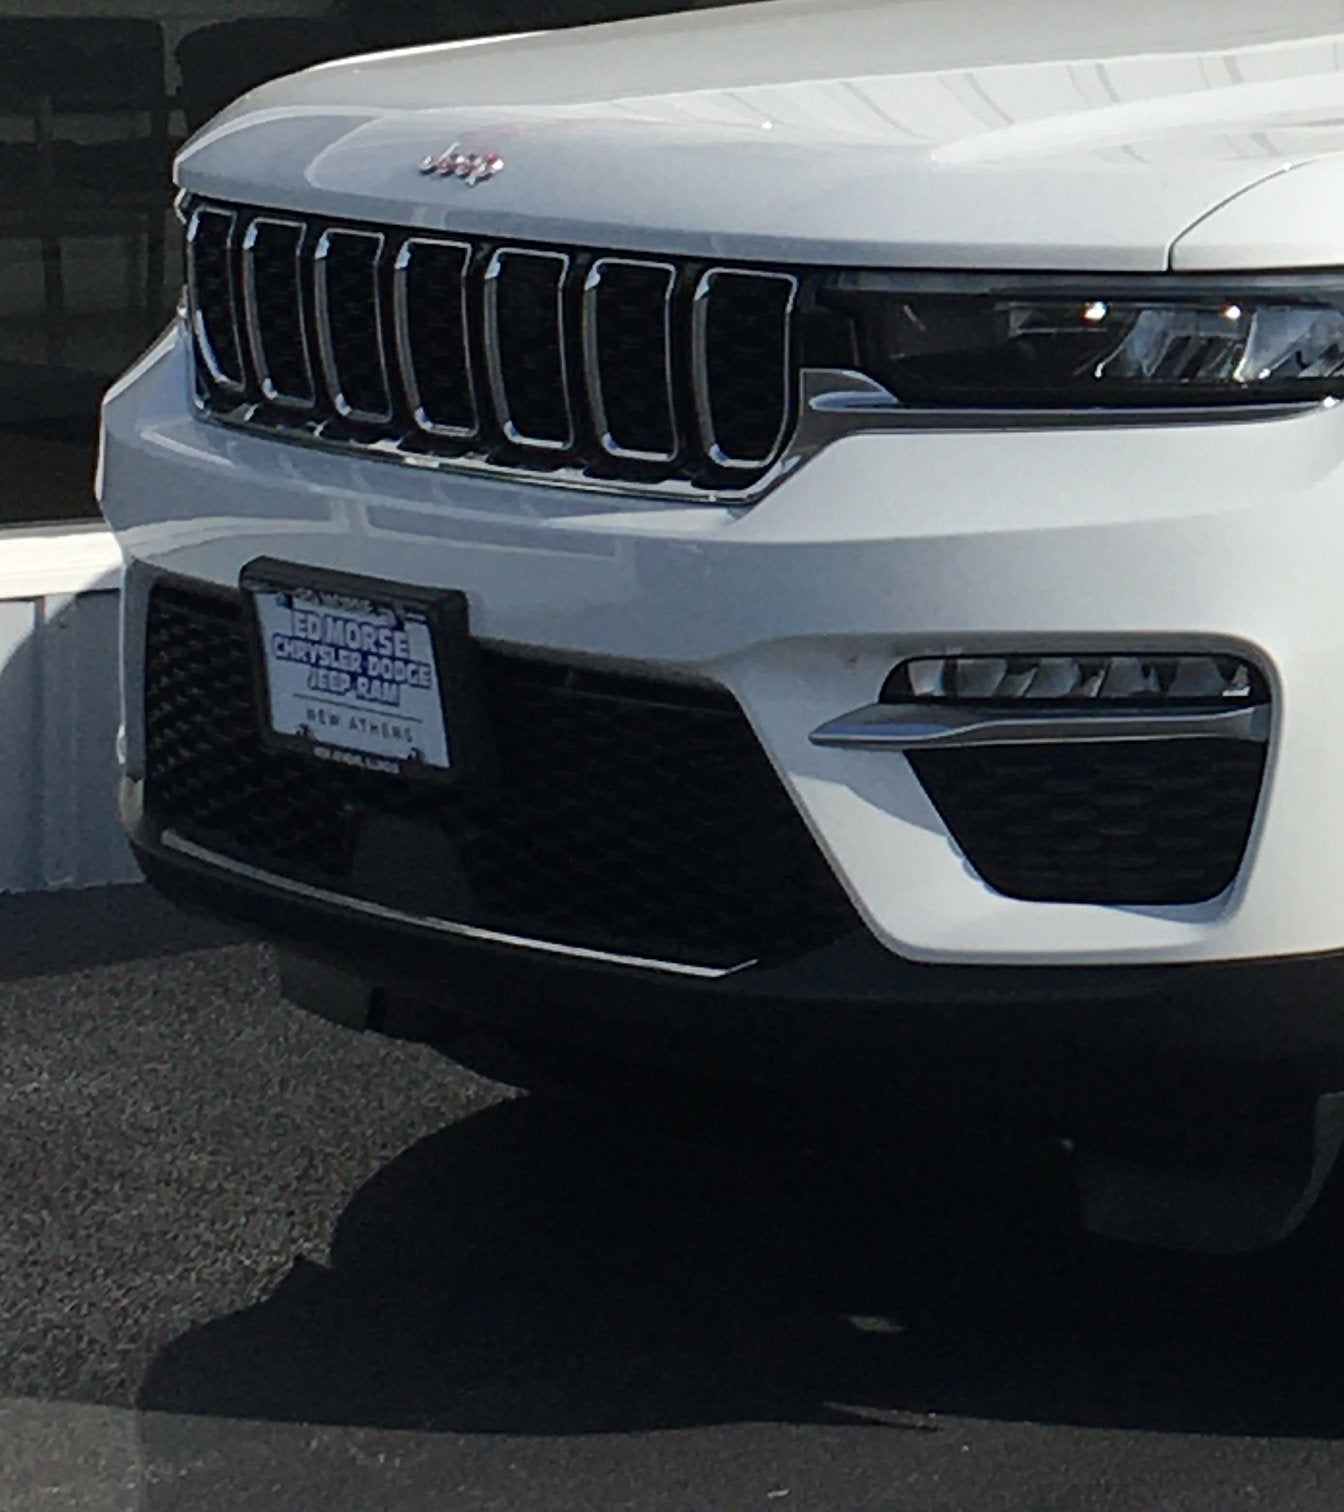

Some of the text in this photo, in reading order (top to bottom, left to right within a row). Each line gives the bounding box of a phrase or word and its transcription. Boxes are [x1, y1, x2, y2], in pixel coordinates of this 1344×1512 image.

[293, 609, 411, 659] ED MORSE
[273, 634, 432, 689] CHRYSLER DODGE
[307, 668, 401, 707] JEEP RAM
